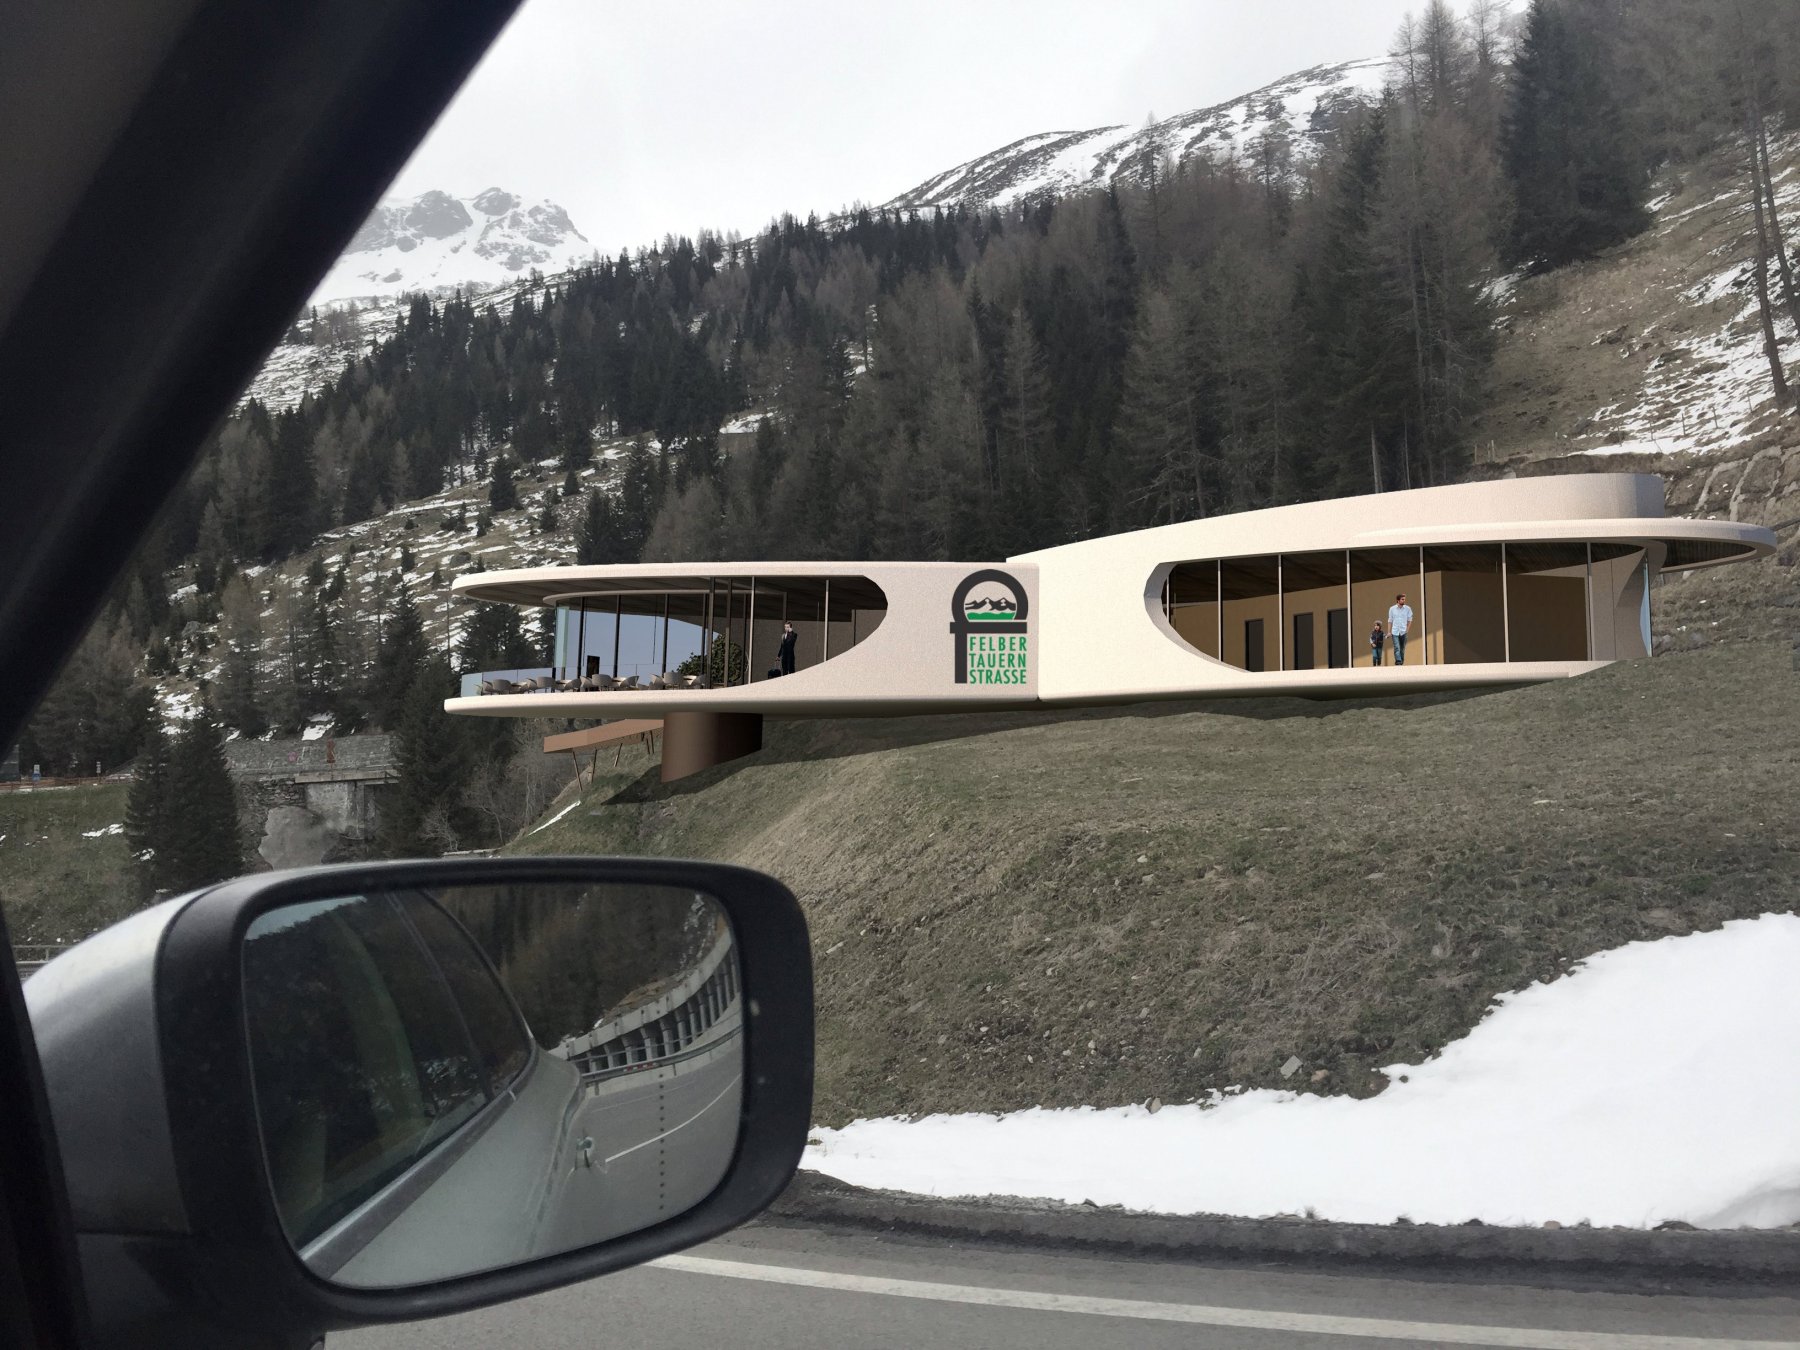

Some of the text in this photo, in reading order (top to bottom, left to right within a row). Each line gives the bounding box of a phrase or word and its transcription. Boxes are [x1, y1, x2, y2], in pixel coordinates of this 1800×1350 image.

[969, 636, 1027, 651] FELBER
[969, 653, 1026, 668] TAUERN
[969, 669, 1027, 684] STRASSE
